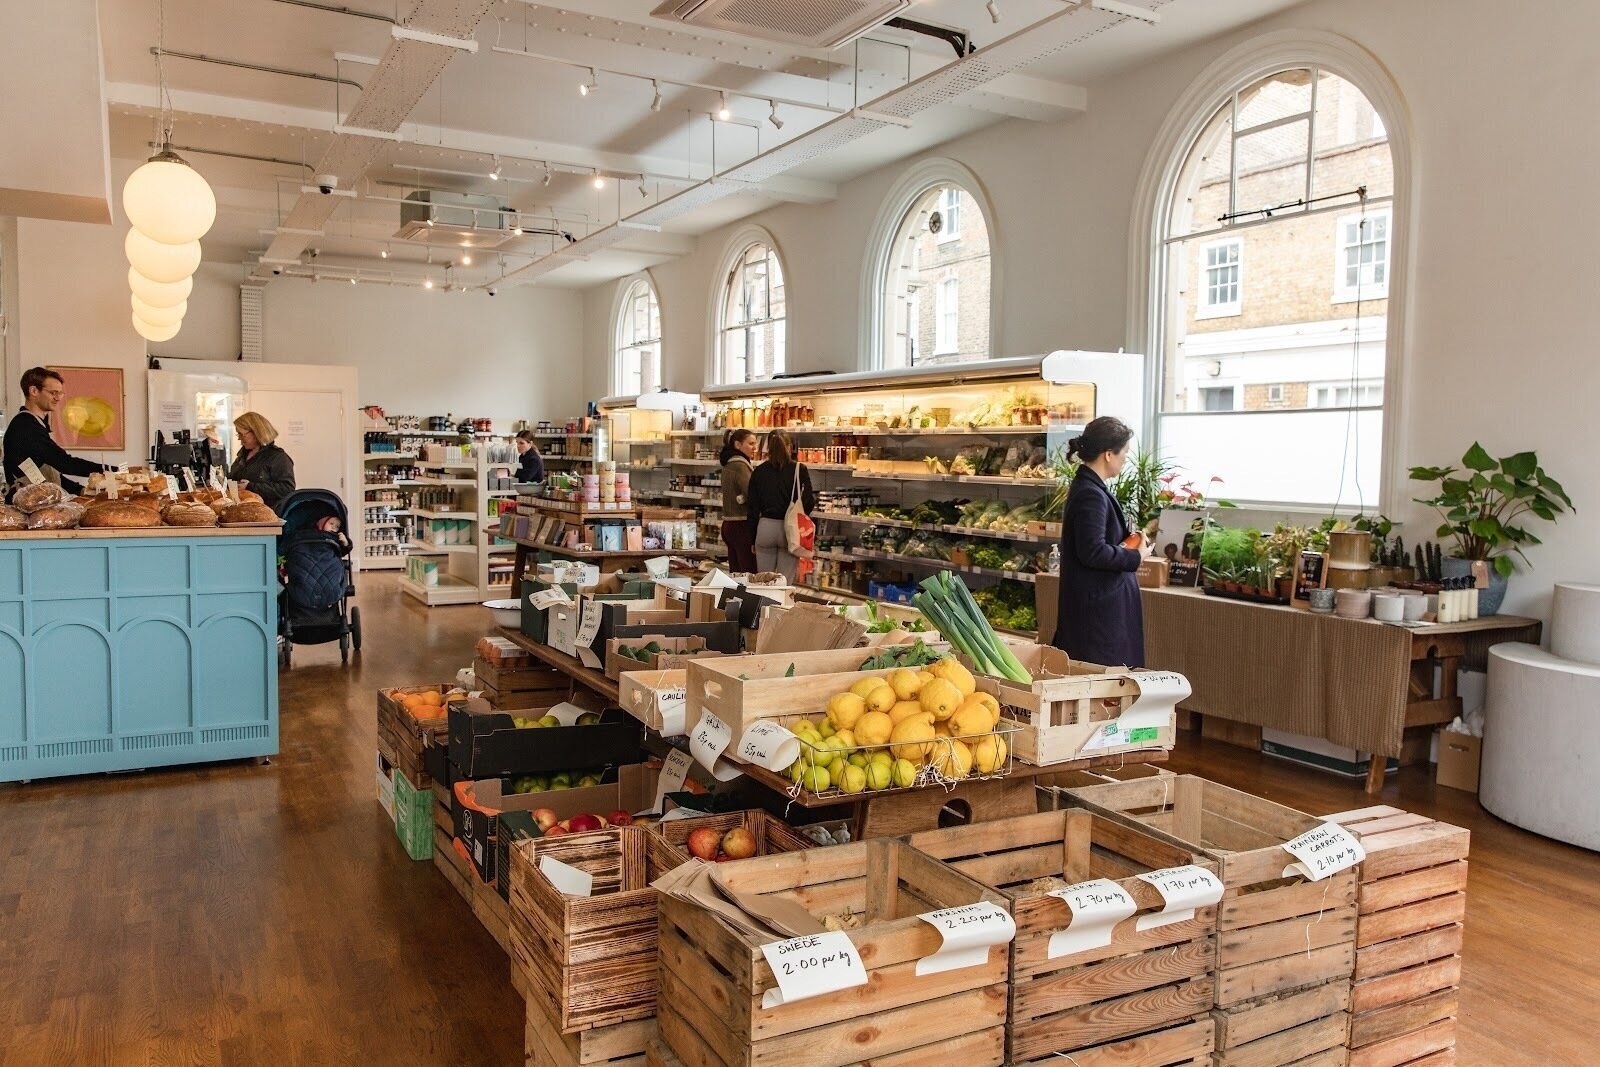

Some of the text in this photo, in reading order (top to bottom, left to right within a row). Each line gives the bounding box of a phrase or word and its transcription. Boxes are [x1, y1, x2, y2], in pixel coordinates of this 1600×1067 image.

[750, 725, 773, 736] LIME
[1290, 829, 1329, 850] RAINBOW
[1310, 834, 1345, 852] CARROTS
[1346, 848, 1356, 860] kg
[1199, 876, 1212, 887] kg
[1113, 892, 1125, 903] kg
[932, 906, 981, 918] PARSNIPS
[979, 915, 992, 923] per
[995, 912, 1006, 921] kg
[778, 937, 821, 954] SWEDE
[822, 955, 835, 968] per
[839, 951, 851, 966] kg
